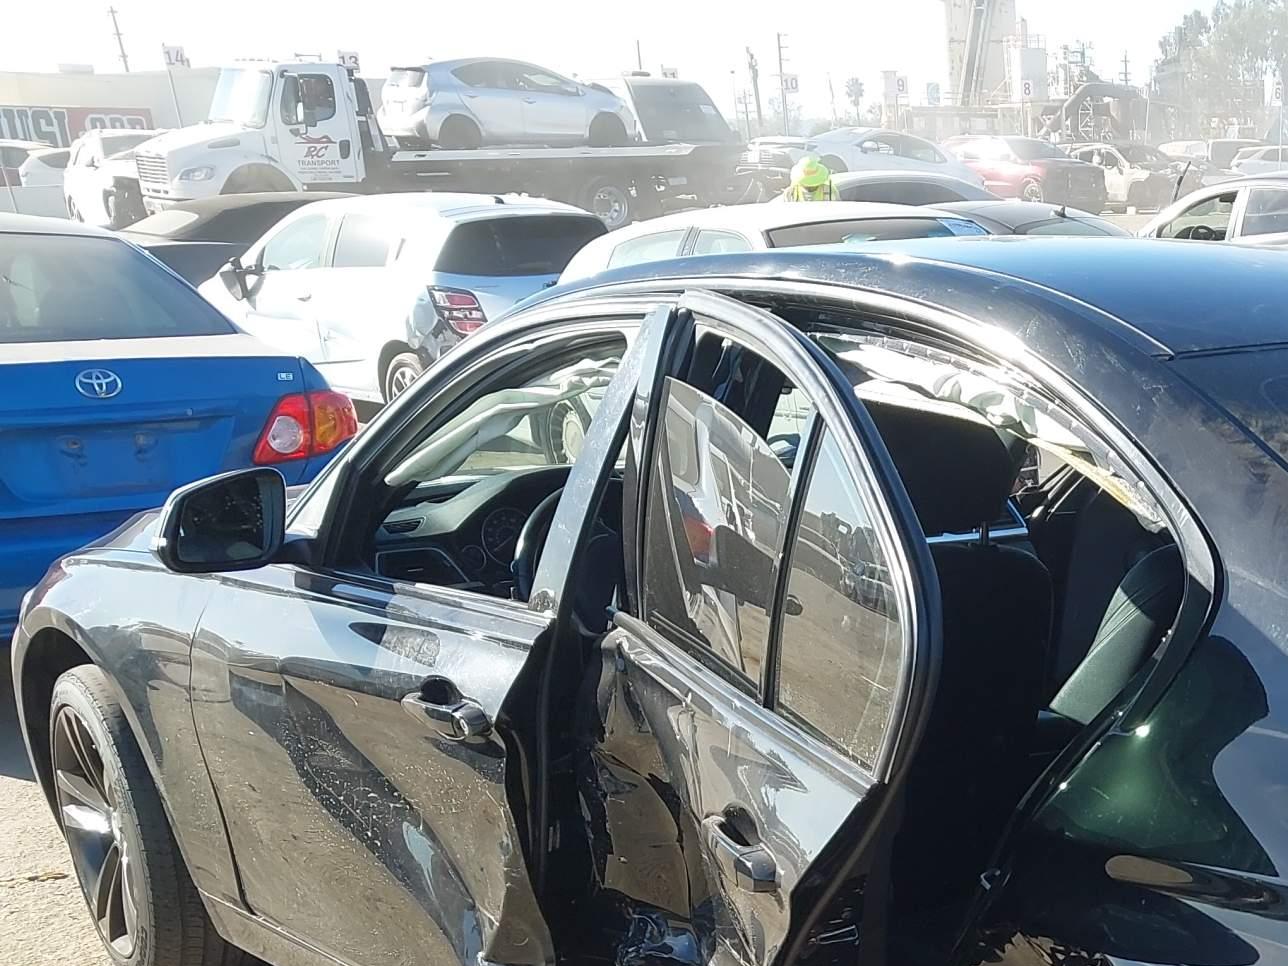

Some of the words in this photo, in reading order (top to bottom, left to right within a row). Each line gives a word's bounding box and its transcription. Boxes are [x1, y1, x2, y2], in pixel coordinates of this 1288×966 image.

[164, 49, 185, 66] 14
[338, 55, 359, 66] 13
[783, 77, 798, 90] 10
[896, 78, 905, 92] 9
[1023, 82, 1031, 96] 8
[1274, 87, 1281, 100] 6
[297, 159, 340, 167] TRANSPORT
[277, 372, 293, 381] LE
